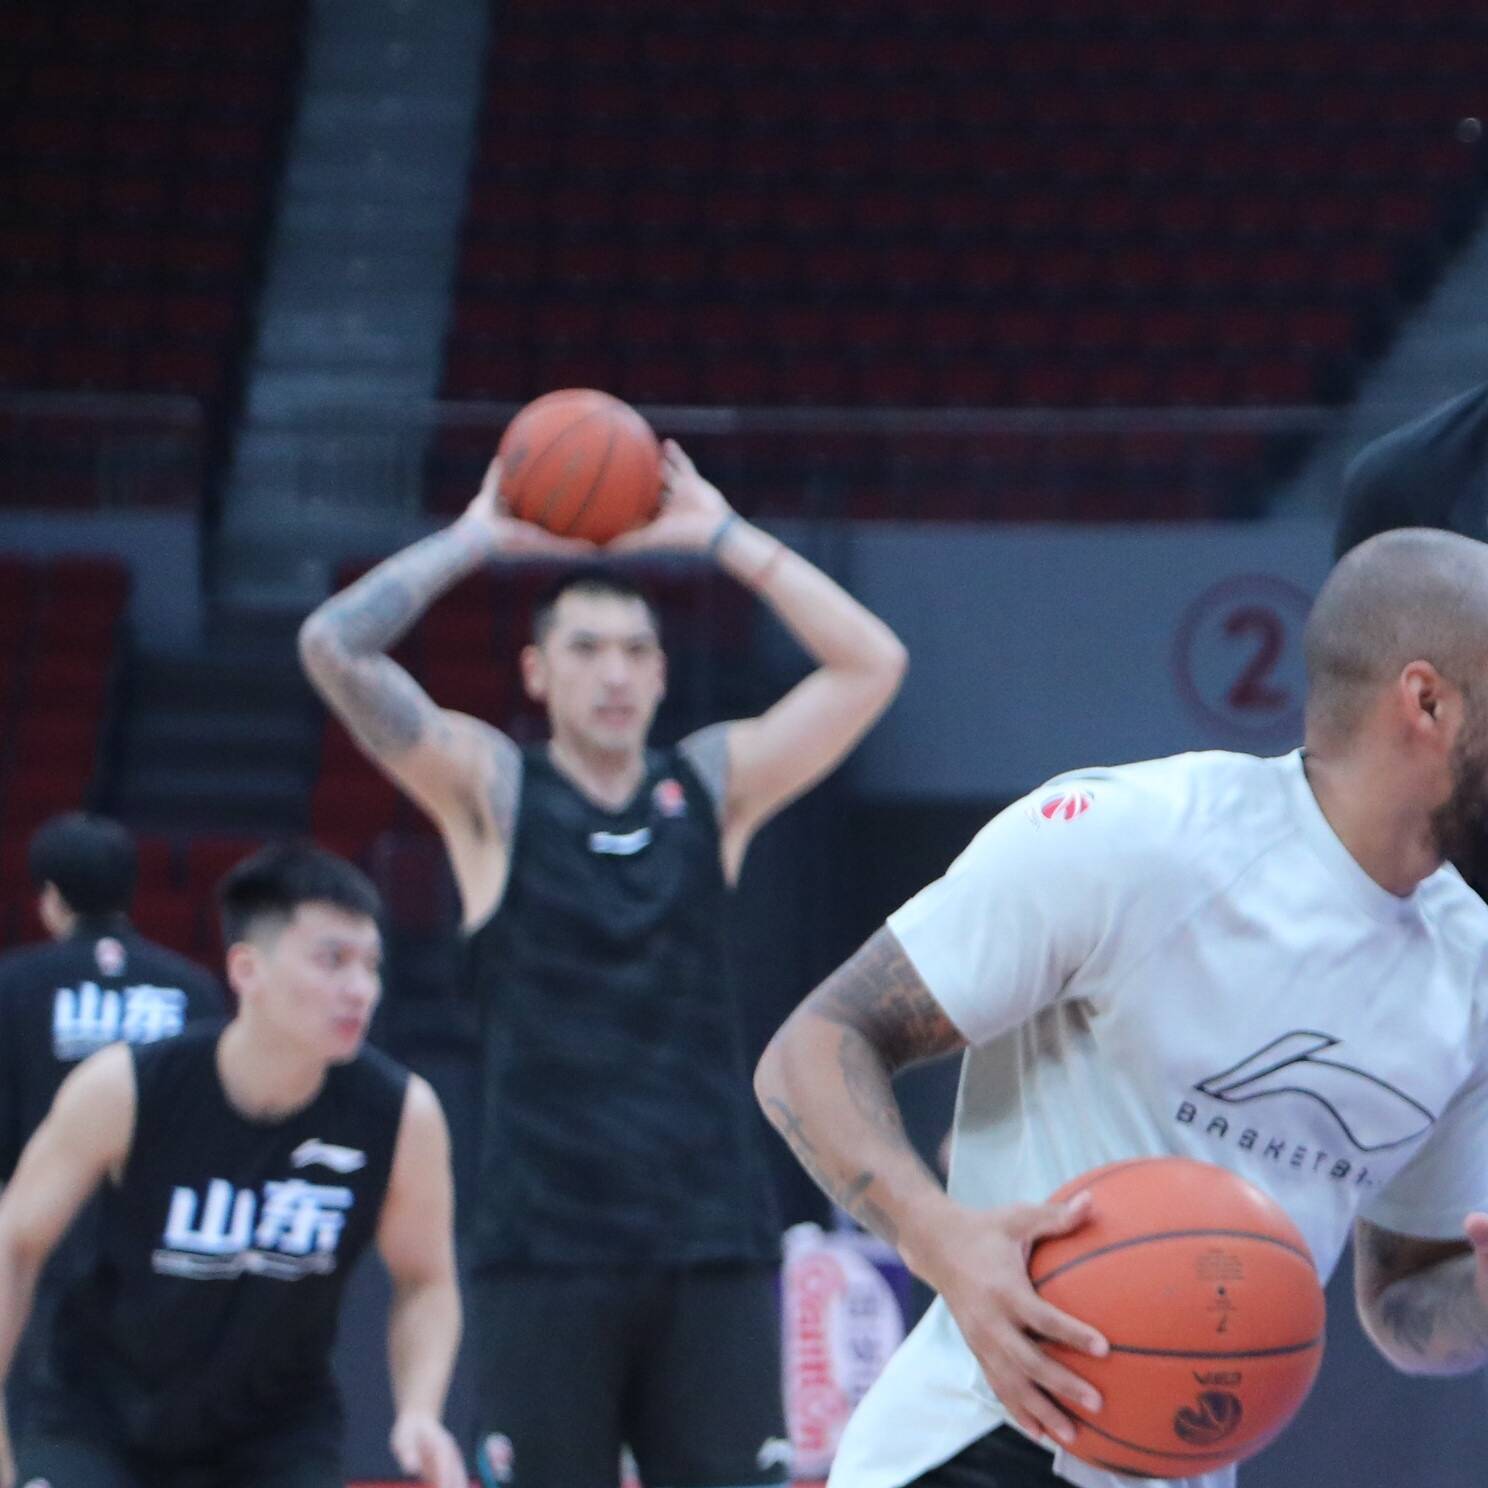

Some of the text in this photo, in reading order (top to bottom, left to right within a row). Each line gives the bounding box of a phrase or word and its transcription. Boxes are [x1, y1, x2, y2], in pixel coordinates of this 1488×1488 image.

[1226, 608, 1289, 709] 2
[54, 981, 188, 1044] 山东
[164, 1177, 355, 1254] 山东
